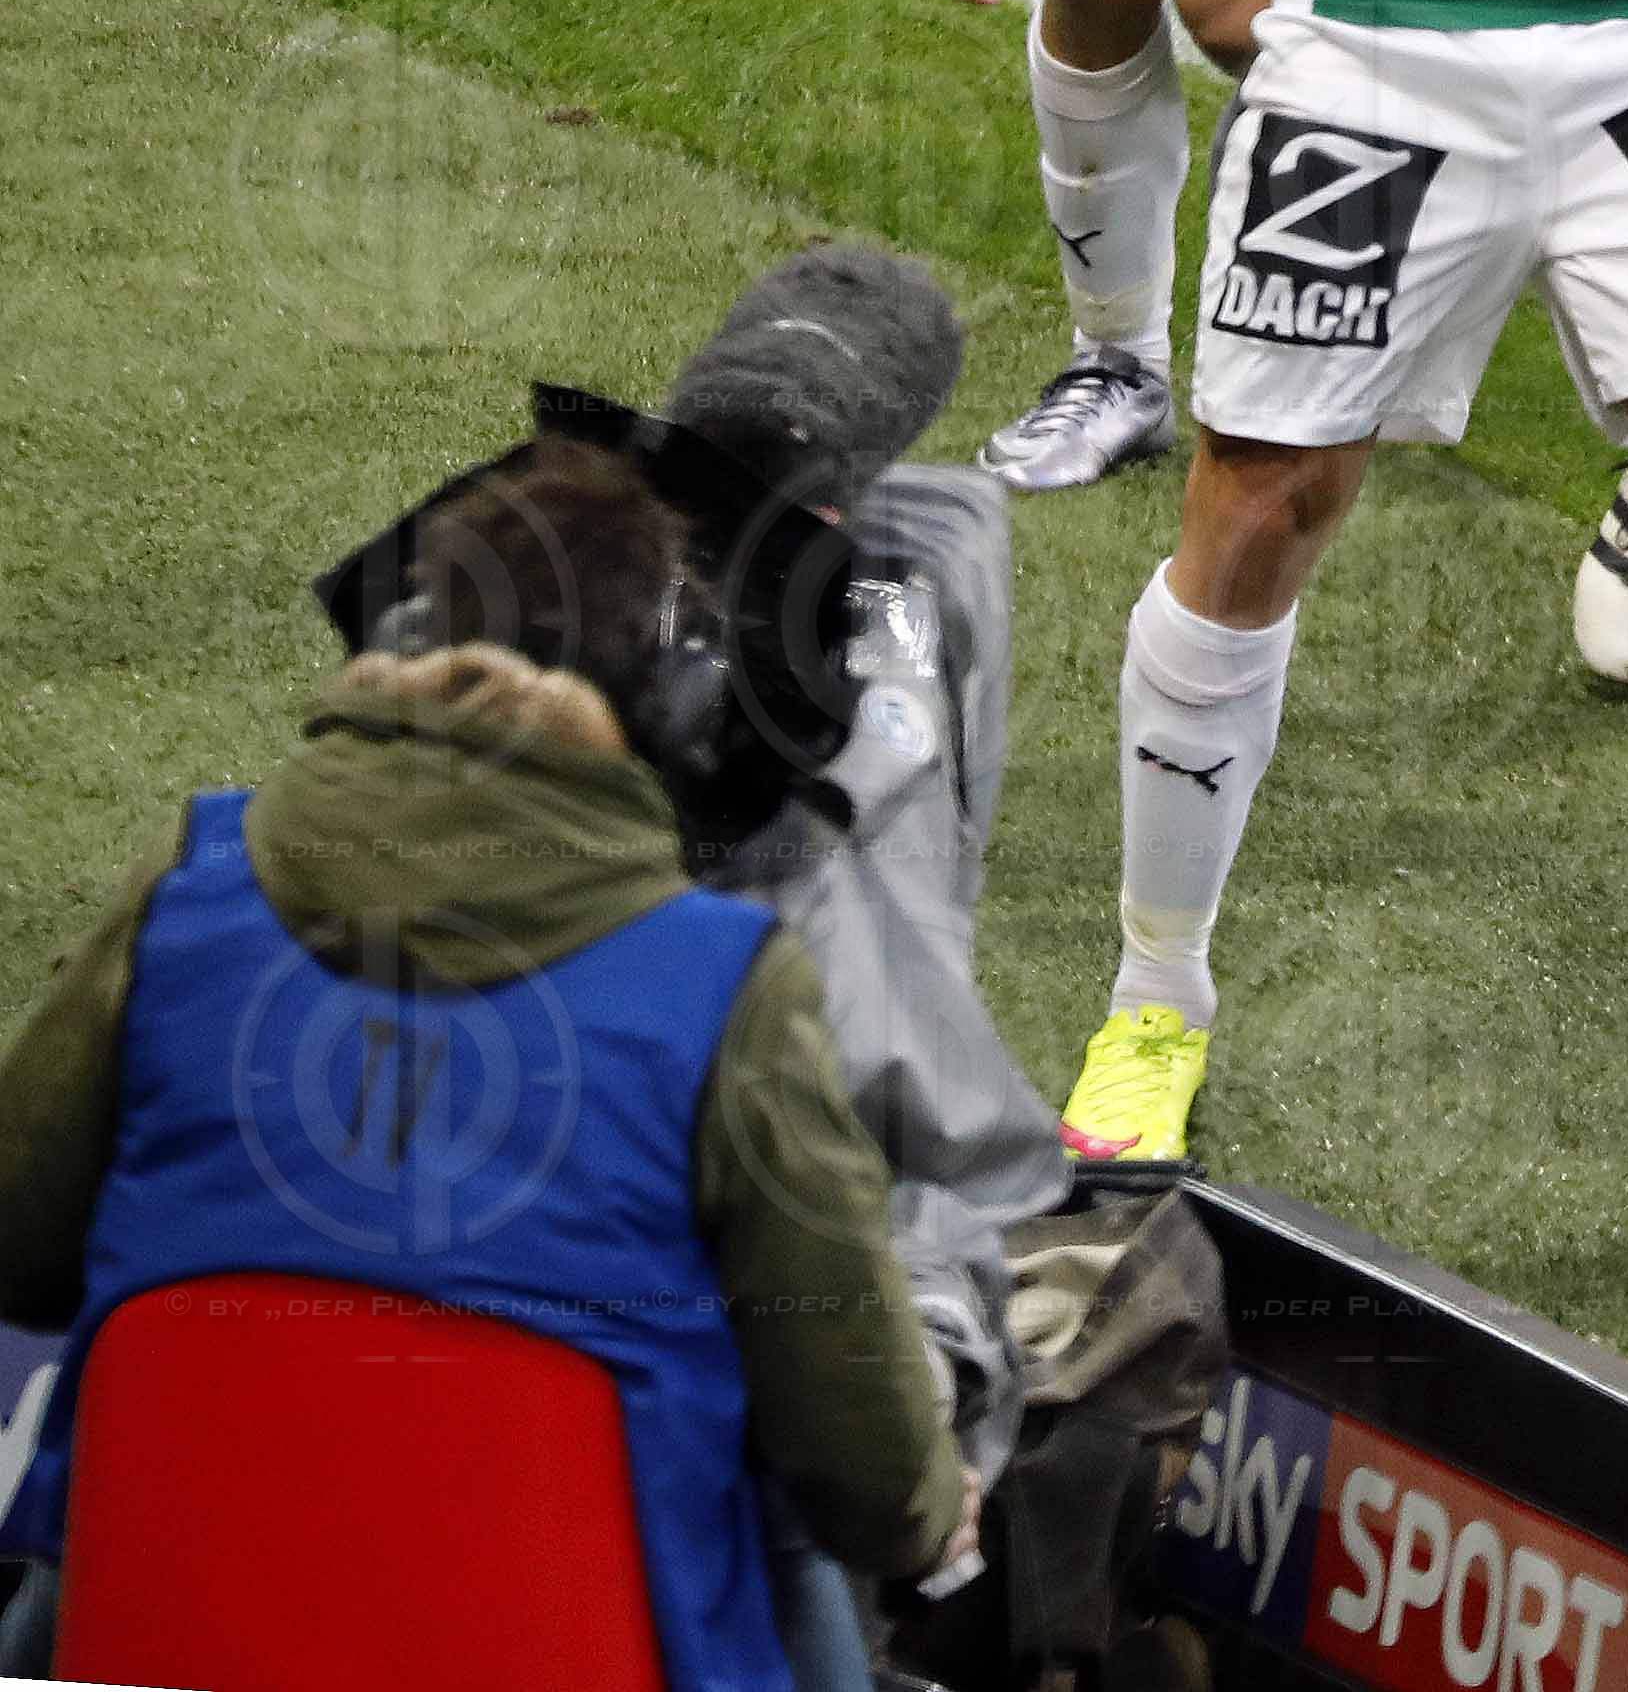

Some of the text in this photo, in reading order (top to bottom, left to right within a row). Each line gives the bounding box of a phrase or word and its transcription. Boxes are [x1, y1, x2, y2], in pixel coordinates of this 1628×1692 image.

[1216, 265, 1392, 343] DACH
[1178, 1373, 1624, 1692] sky SPORT
